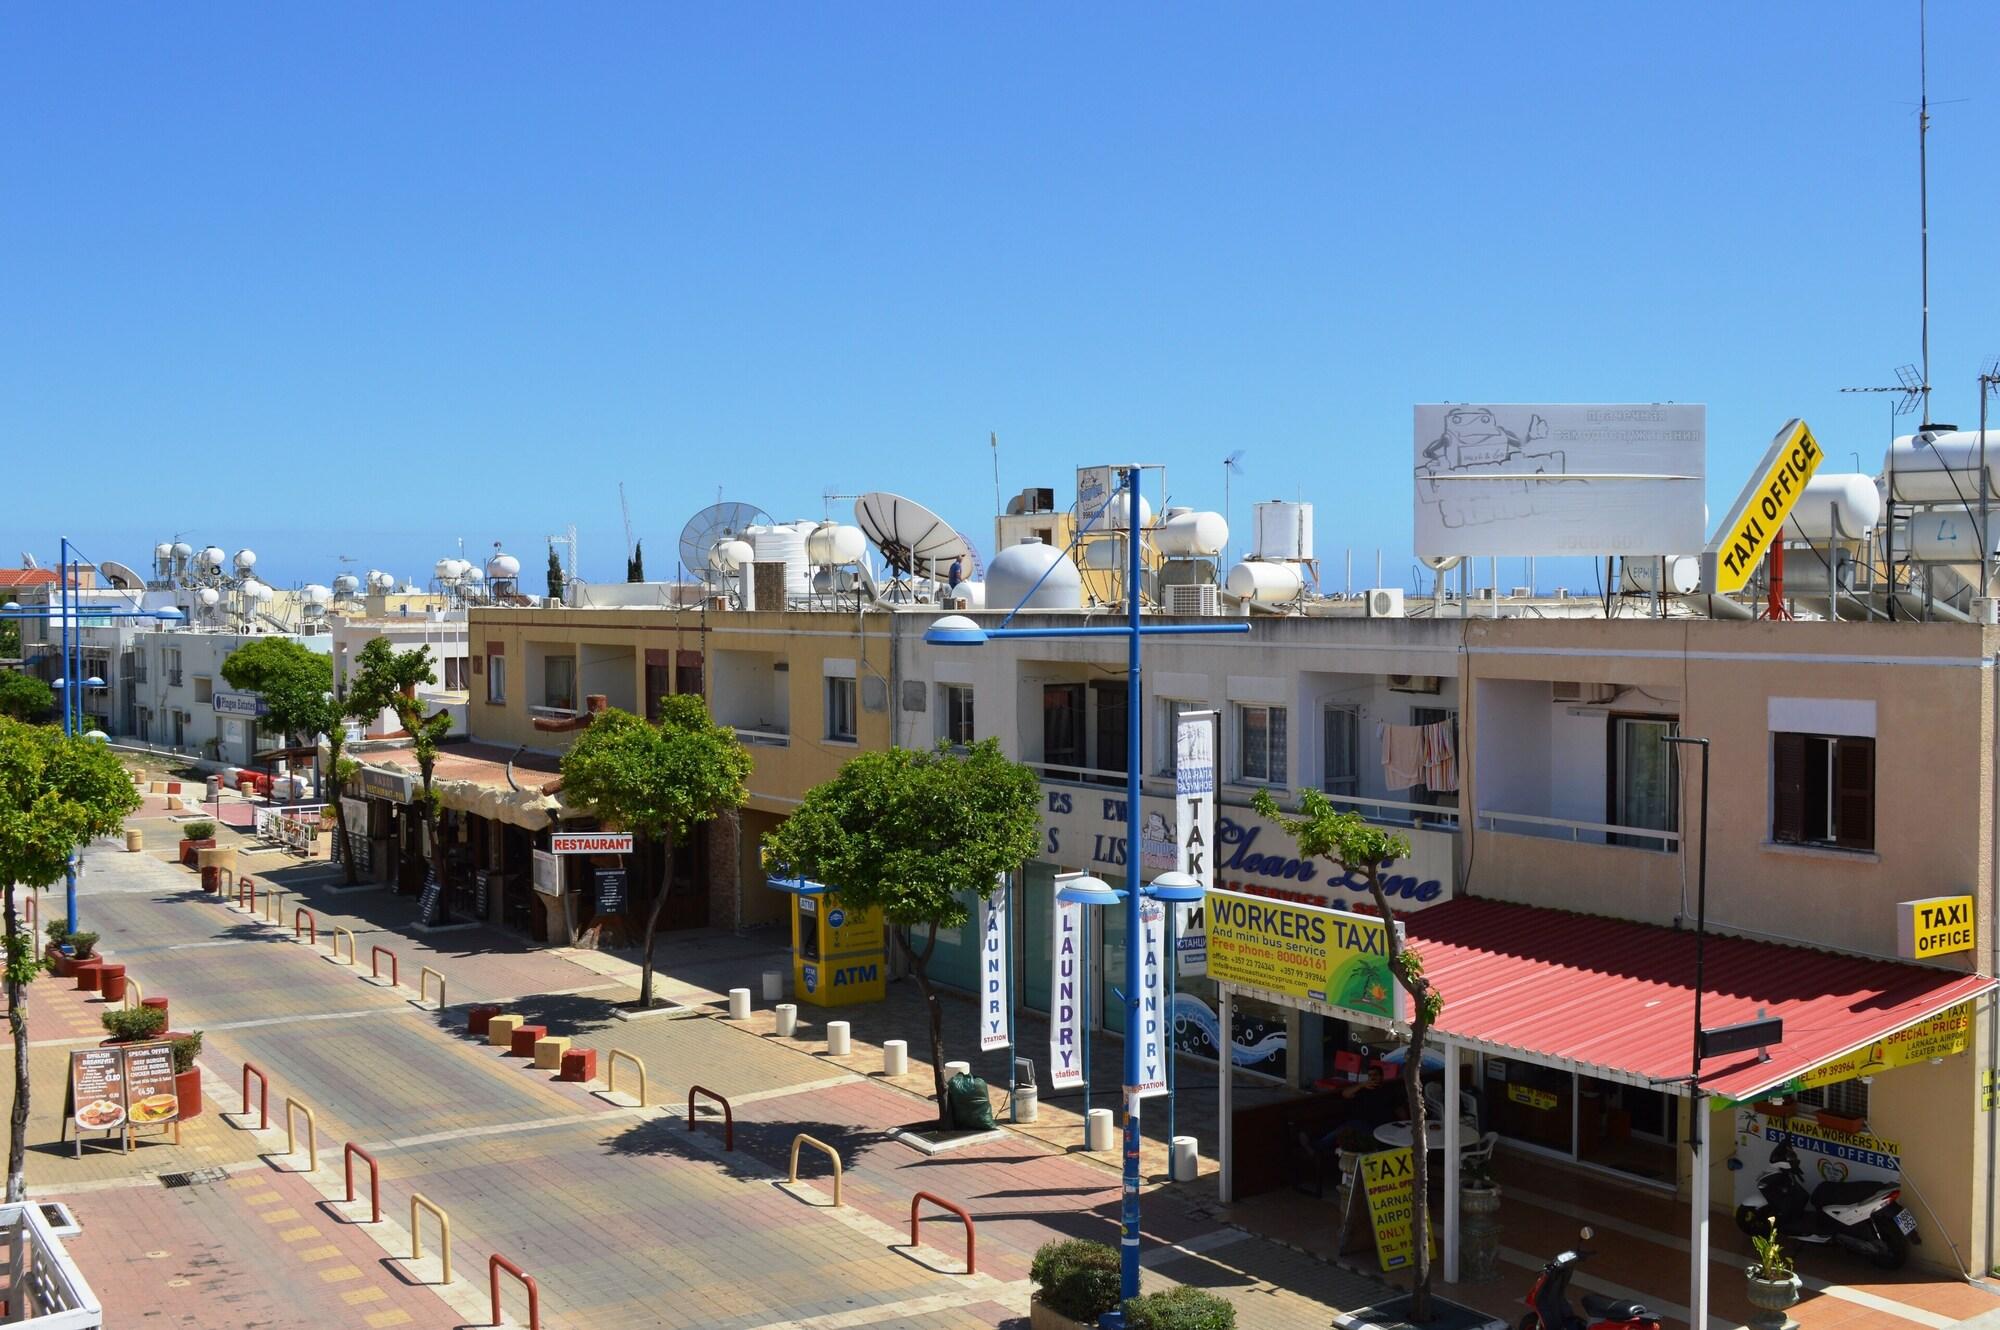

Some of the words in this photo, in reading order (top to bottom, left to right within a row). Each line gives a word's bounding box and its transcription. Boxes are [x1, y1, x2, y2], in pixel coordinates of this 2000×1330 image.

[1724, 517, 1765, 576] TAXI
[1761, 433, 1816, 521] OFFICE
[554, 839, 632, 850] RESTAURANT
[1186, 798, 1204, 929] ТАКИ
[1212, 898, 1326, 944] WORKERS
[1333, 920, 1385, 957] TAXI
[1921, 904, 1967, 929] TAXI
[1212, 927, 1232, 938] And
[1236, 931, 1259, 943] mini
[1263, 936, 1282, 948] bus
[1286, 941, 1326, 957] service
[1919, 929, 1970, 950] OFFICE
[1212, 937, 1235, 951] Free
[1239, 944, 1274, 960] phone:
[1277, 951, 1327, 970] 80006161
[834, 964, 878, 986] ATM
[1060, 915, 1074, 1068] LAUNDRY
[1145, 928, 1157, 1080] LAUNDRY
[1948, 1003, 1968, 1019] TAXI
[983, 1034, 1007, 1044] STATION
[1888, 1030, 1928, 1045] SPECIAL
[1933, 1016, 1968, 1034] PRICES
[1907, 1037, 1938, 1051] LARNACA
[1941, 1031, 1966, 1042] AIRPORT
[128, 1049, 150, 1057] SPECIAL
[151, 1047, 170, 1055] OFFER
[1911, 1046, 1935, 1059] SEATER
[1938, 1041, 1954, 1052] ONLY
[1055, 1070, 1080, 1079] station
[1818, 1068, 1827, 1078] 99
[1829, 1062, 1855, 1076] 393964
[1767, 1117, 1789, 1130] AYI
[1792, 1120, 1819, 1137] NAPA
[1822, 1127, 1873, 1149] WORKERS
[1875, 1139, 1898, 1155] TAXI
[1365, 1153, 1413, 1181] TAX
[1838, 1147, 1894, 1169] OFFERS
[1373, 1193, 1414, 1210] LARNAC
[1377, 1207, 1412, 1226] AIRPO
[1380, 1226, 1405, 1240] ONLY
